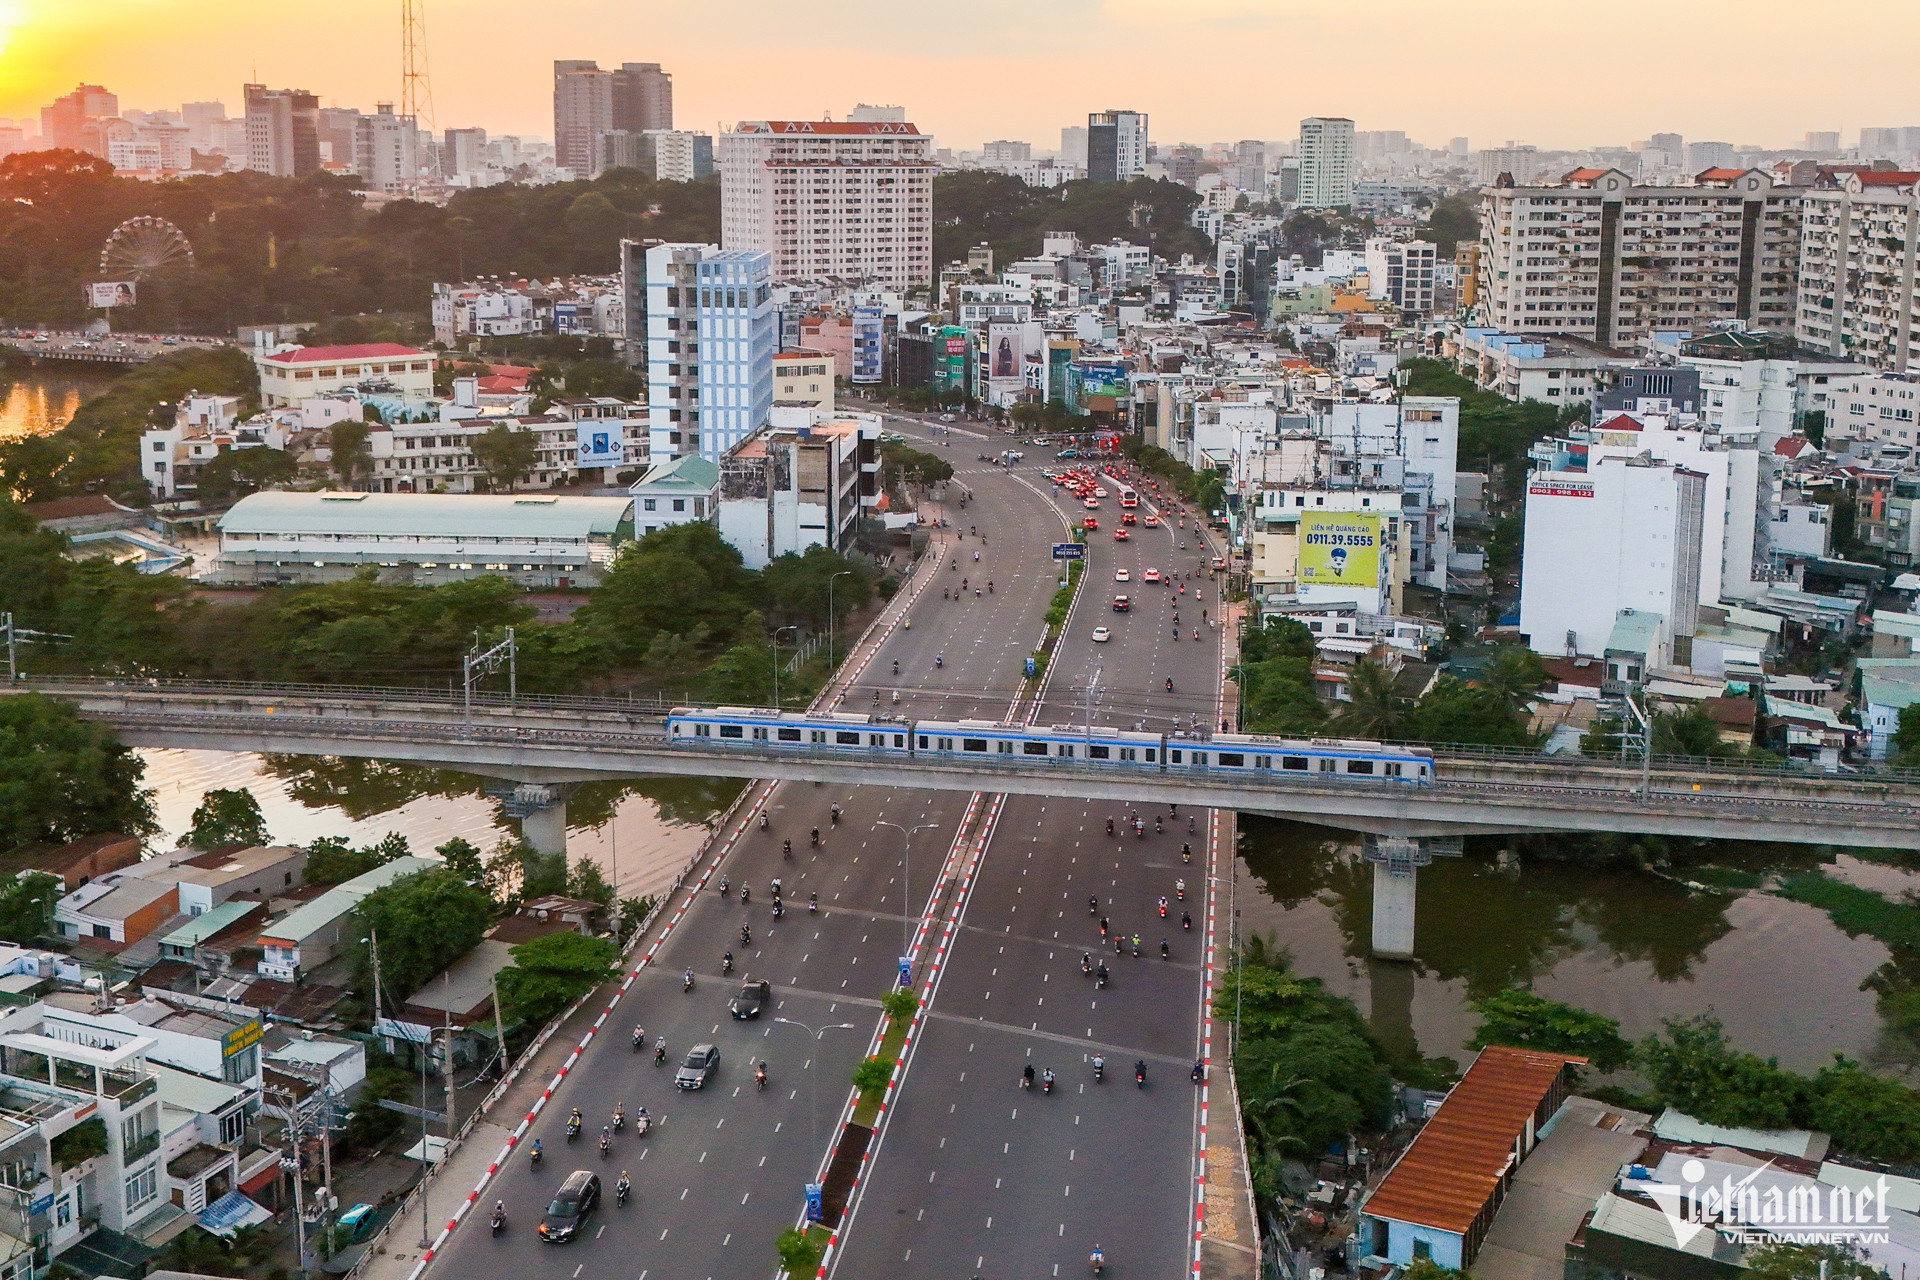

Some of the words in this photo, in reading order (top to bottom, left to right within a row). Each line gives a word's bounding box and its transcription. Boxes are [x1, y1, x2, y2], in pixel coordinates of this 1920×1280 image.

[1607, 178, 1618, 191] D
[1748, 178, 1759, 191] D
[1307, 533, 1373, 546] 0911.39.5555
